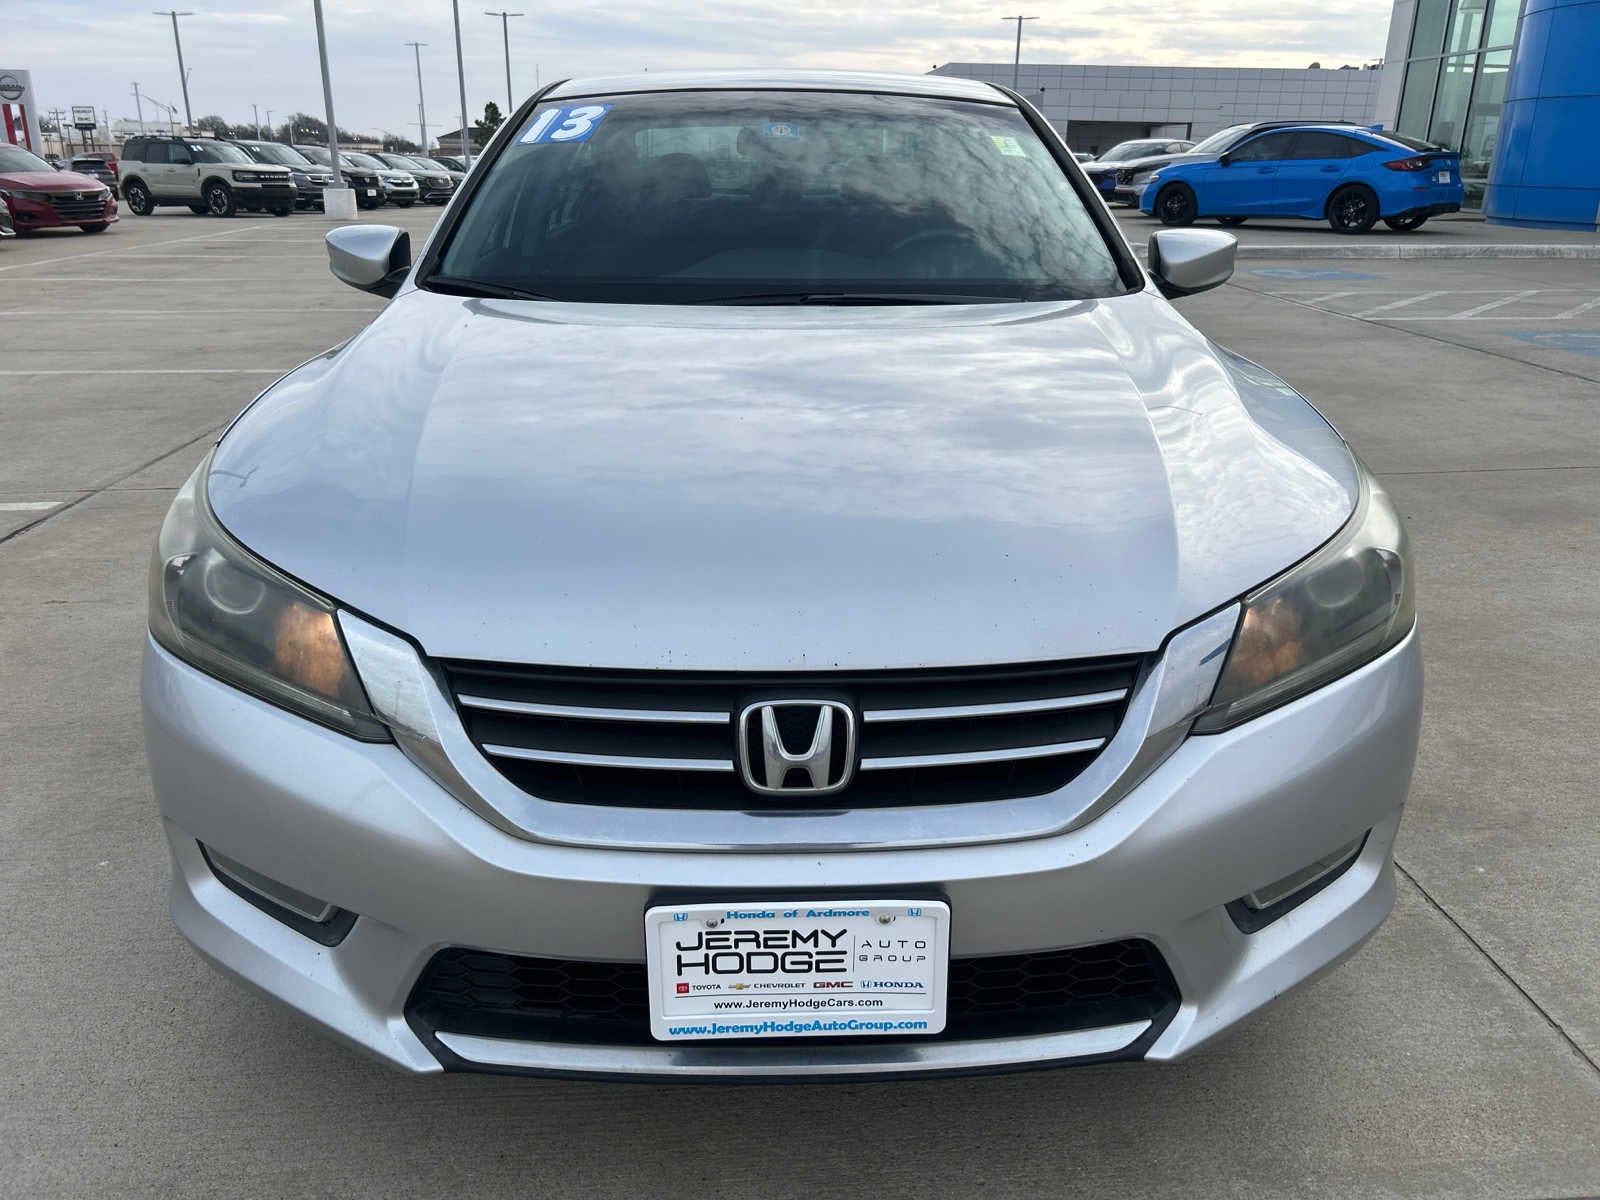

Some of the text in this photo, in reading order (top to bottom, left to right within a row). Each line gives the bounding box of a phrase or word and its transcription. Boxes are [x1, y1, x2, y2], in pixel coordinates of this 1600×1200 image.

[520, 106, 606, 143] 13
[726, 909, 870, 919] Honda of Ardmore
[676, 929, 847, 951] JEREMY
[861, 940, 926, 949] AUTO
[676, 950, 847, 976] HODGE
[713, 998, 883, 1010] www.JeremyHodgeCars.com
[669, 1019, 928, 1035] www.JeremyHodgeAutoGroup.com
